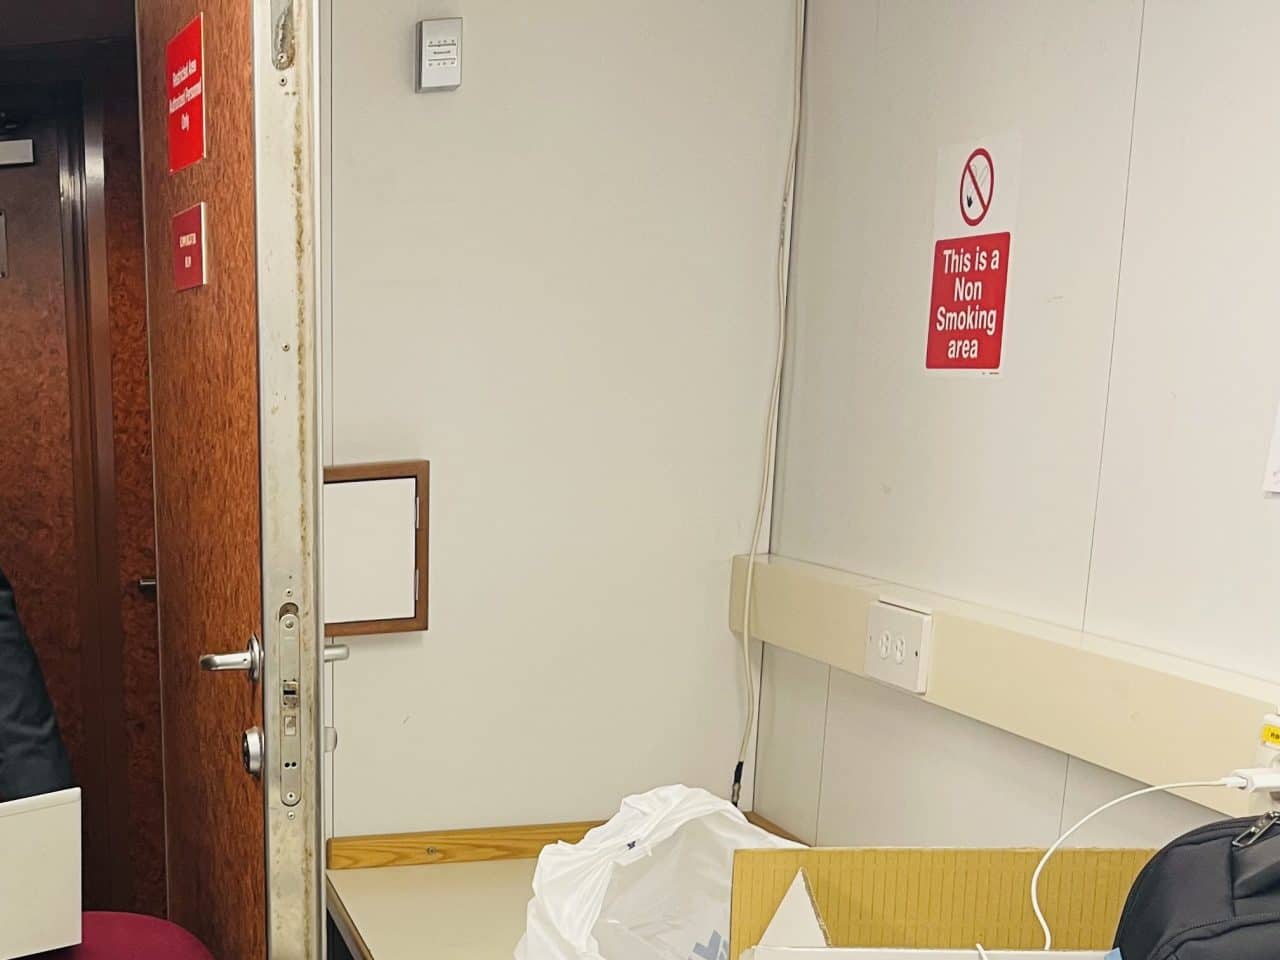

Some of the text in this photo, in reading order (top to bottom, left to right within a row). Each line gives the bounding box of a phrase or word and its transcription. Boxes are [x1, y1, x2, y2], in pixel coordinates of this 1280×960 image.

[943, 246, 1000, 274] This is a
[954, 276, 982, 302] Non
[936, 305, 997, 336] Smoking
[947, 339, 979, 359] area
